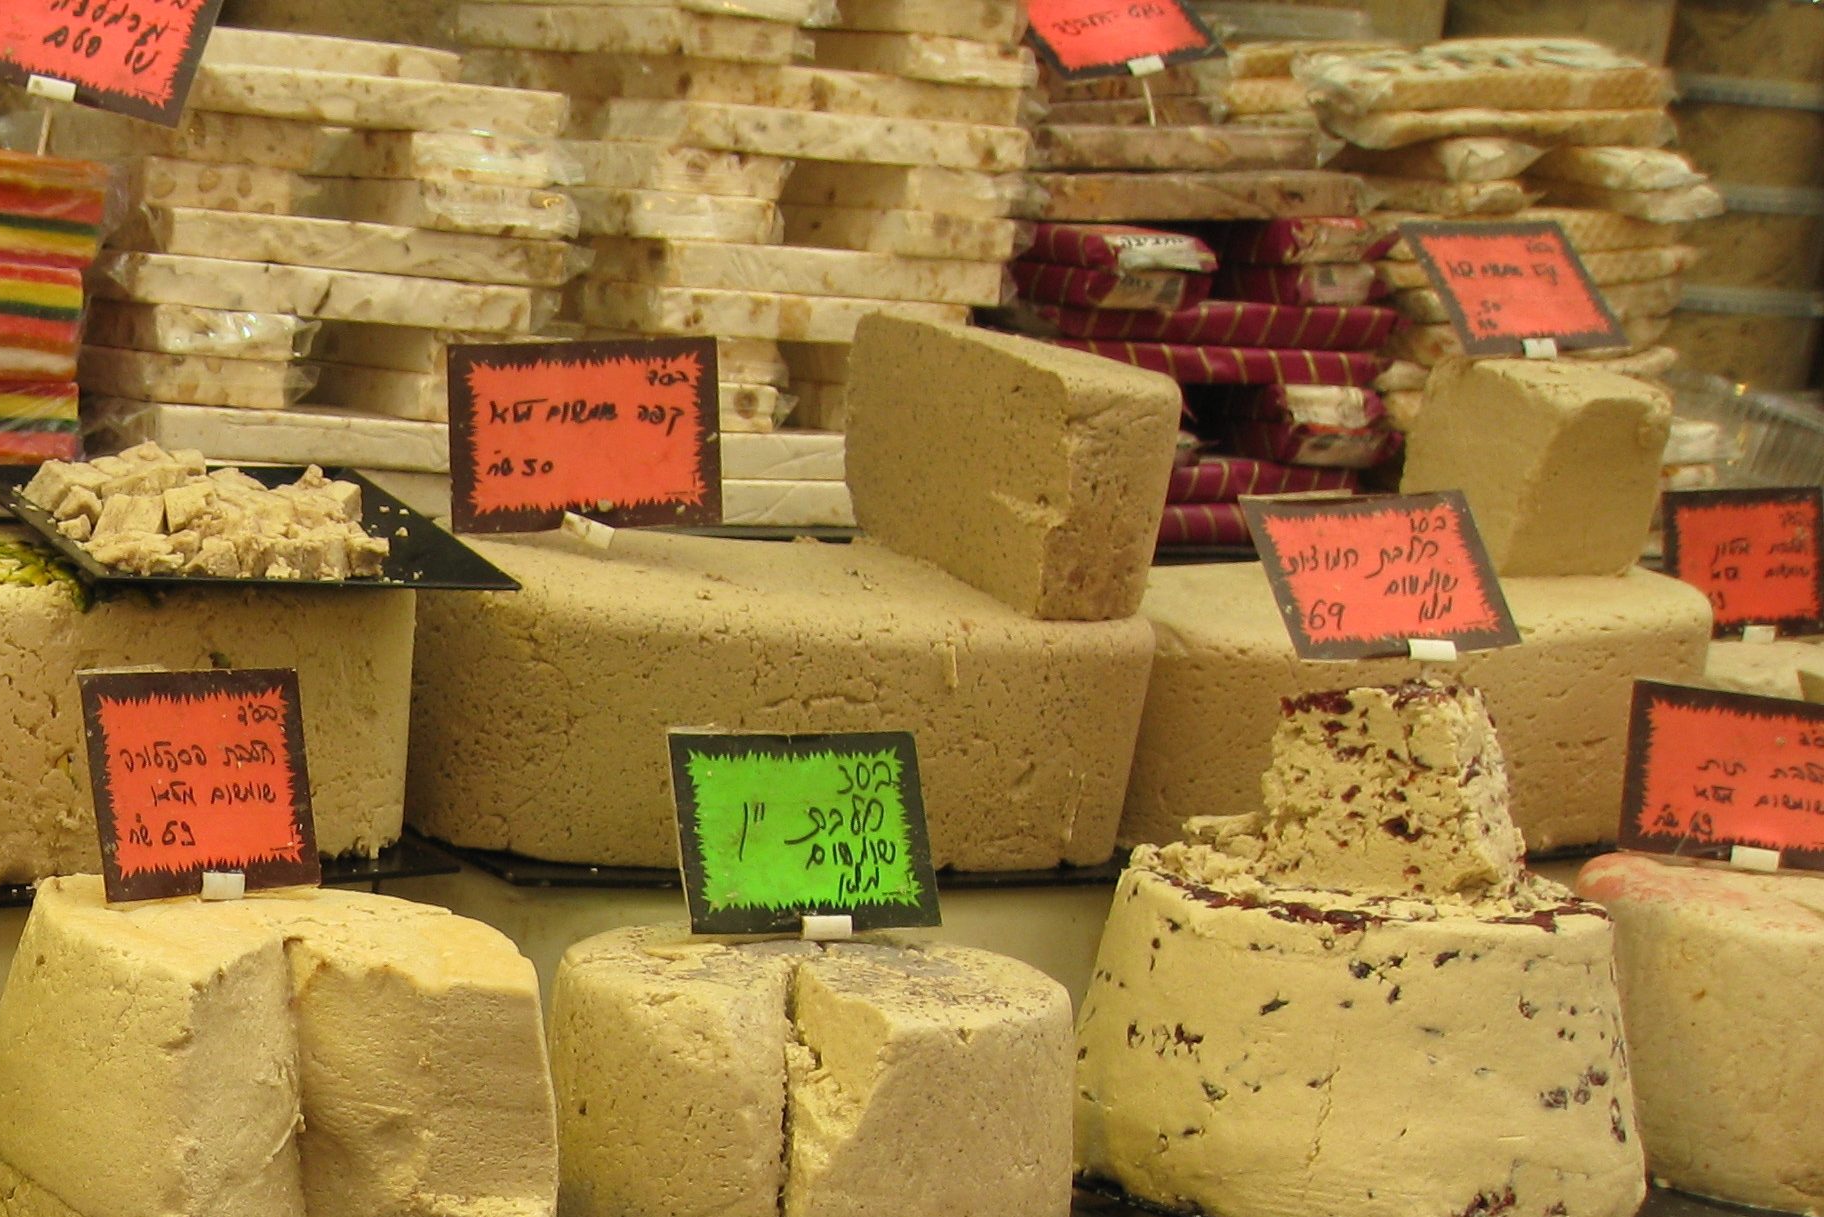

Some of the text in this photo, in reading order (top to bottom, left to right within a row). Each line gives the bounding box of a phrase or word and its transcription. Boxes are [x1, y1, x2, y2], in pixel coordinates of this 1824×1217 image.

[521, 458, 554, 476] 50
[1365, 536, 1438, 579] חלבת
[1308, 599, 1346, 631] 69
[223, 740, 275, 768] חלבת
[150, 780, 276, 807] שומשום מלא
[161, 820, 195, 846] 69
[784, 794, 885, 845] חלבת
[1689, 811, 1713, 836] 69
[805, 836, 896, 870] שומשום
